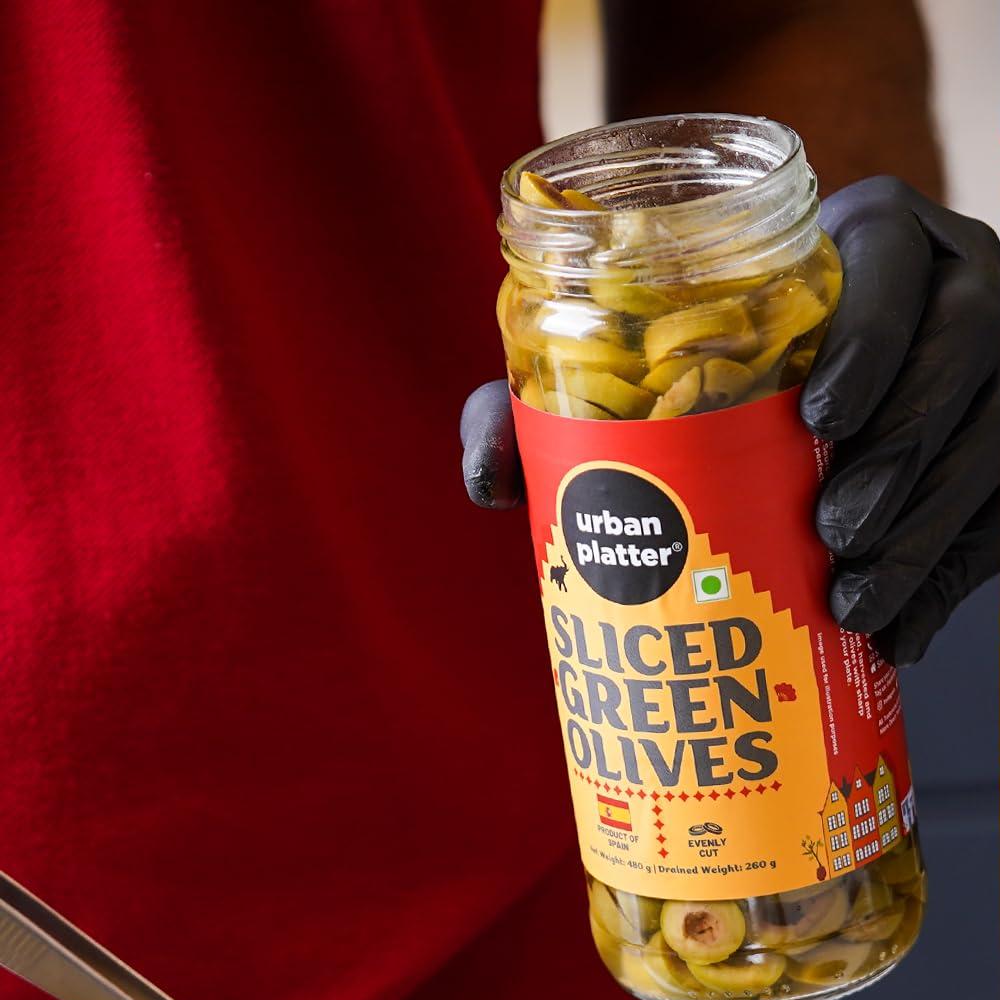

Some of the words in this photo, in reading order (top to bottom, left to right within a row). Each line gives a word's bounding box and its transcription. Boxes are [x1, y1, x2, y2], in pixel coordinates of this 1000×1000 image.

[575, 510, 662, 537] urban
[550, 605, 762, 676] SLICED
[840, 635, 849, 657] your
[849, 636, 857, 665] olives
[820, 655, 828, 673] used
[853, 666, 861, 688] with
[558, 659, 773, 734] GREEN
[858, 652, 870, 699] harvested
[864, 701, 872, 720] and
[825, 684, 834, 722] illustration
[856, 689, 864, 717] sharp
[829, 722, 839, 755] purposes
[567, 718, 779, 787] OLIVES
[597, 825, 628, 842] PRODUCT
[629, 835, 639, 843] OF
[608, 839, 630, 851] SPAIN
[688, 838, 726, 848] EVENLY
[600, 852, 626, 867] Weight:
[627, 860, 643, 870] 480
[645, 866, 652, 874] g
[658, 865, 699, 874] Drained
[701, 865, 743, 875] Weight:
[744, 861, 767, 871] 260
[770, 860, 777, 869] g
[699, 848, 719, 857] CUT
